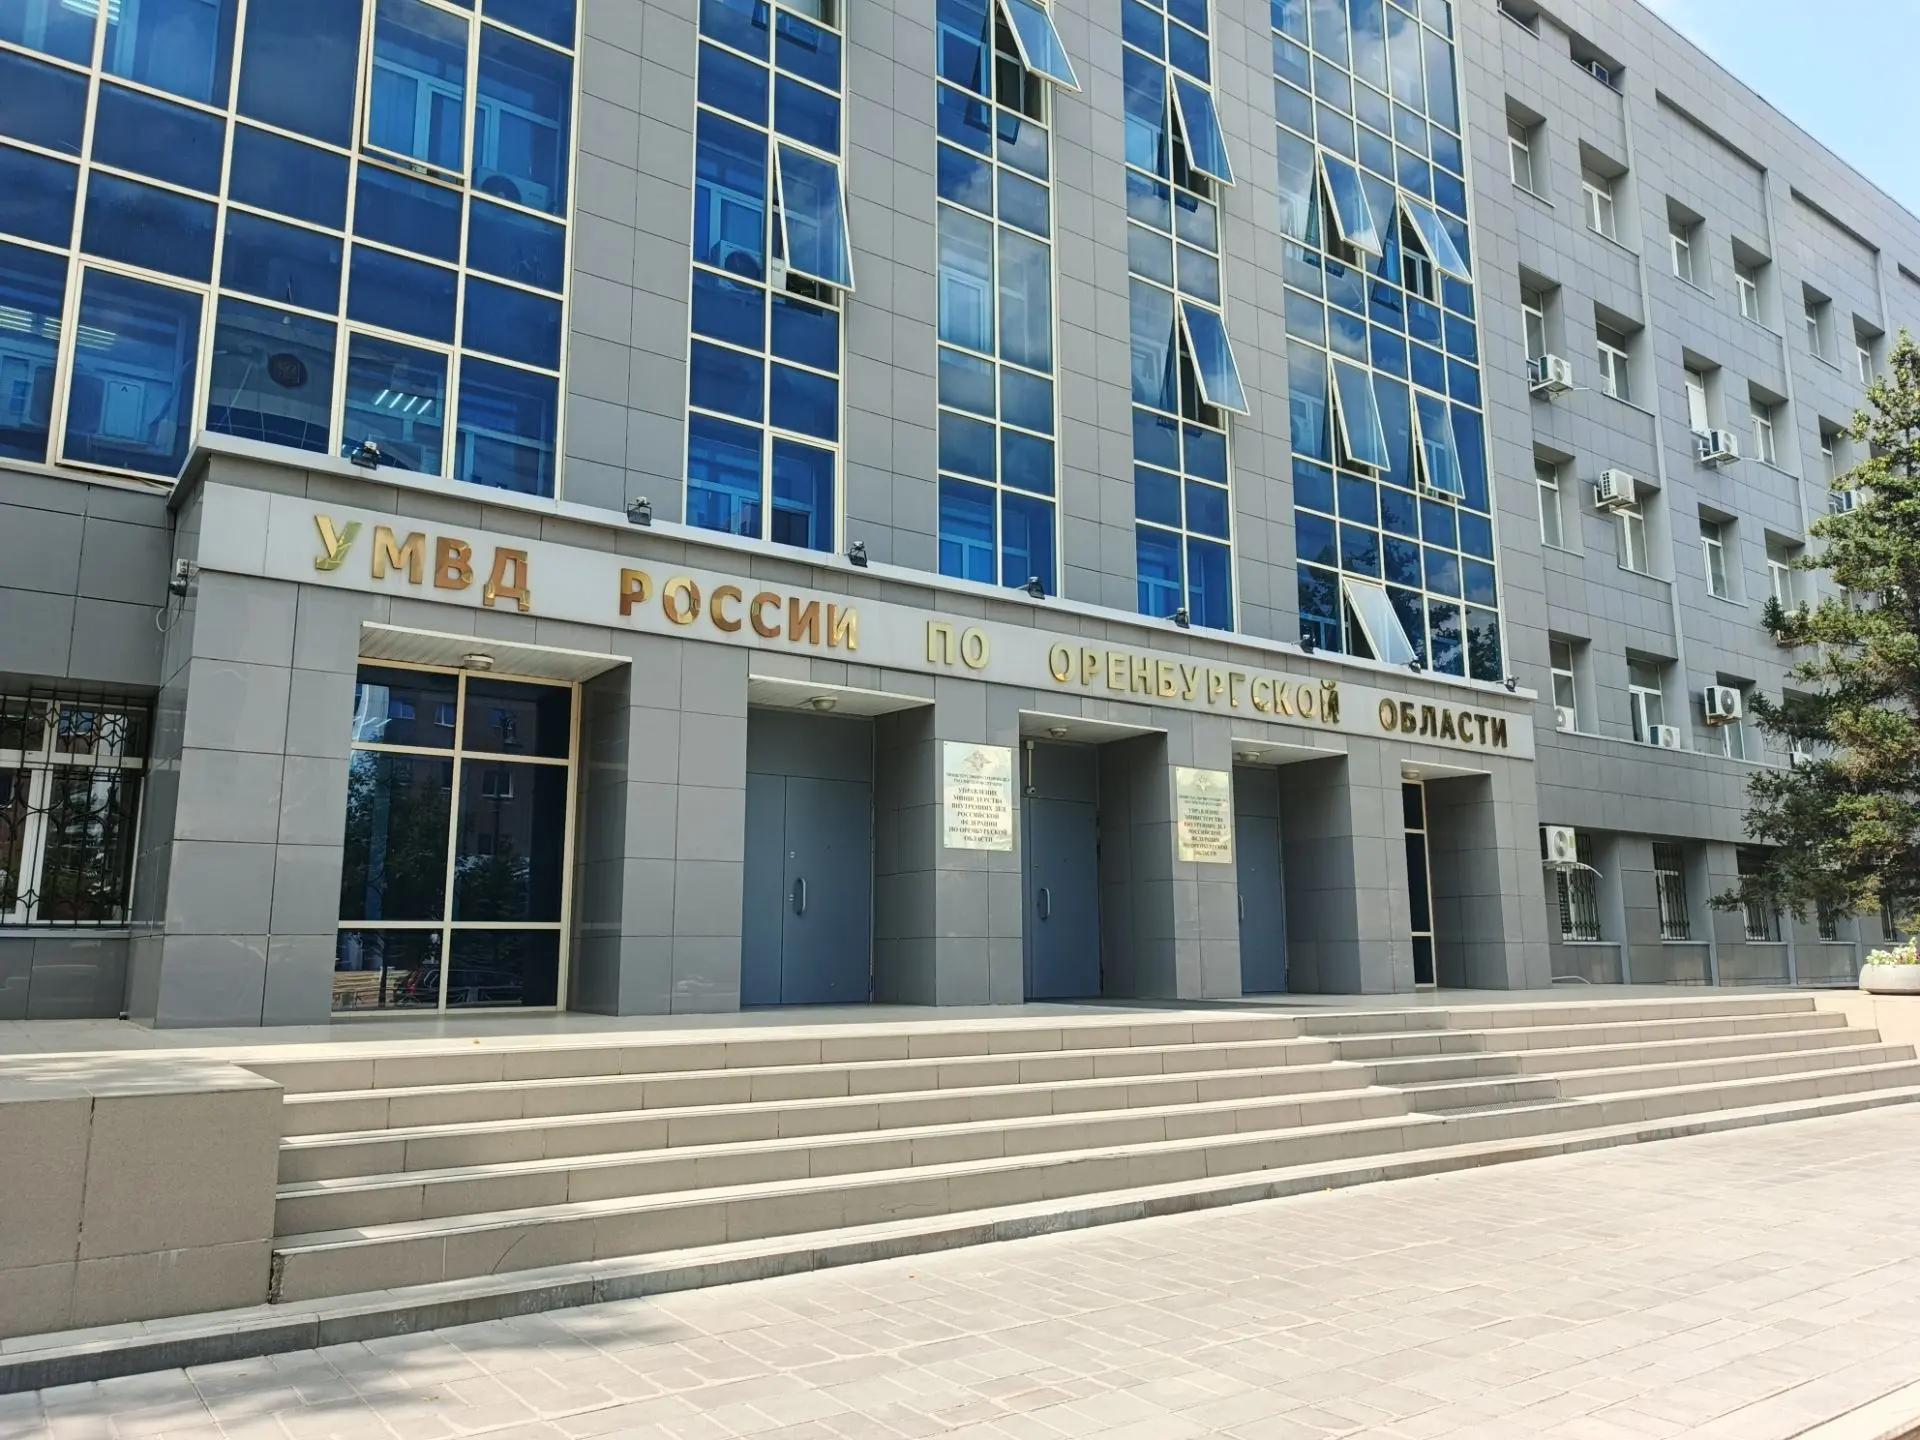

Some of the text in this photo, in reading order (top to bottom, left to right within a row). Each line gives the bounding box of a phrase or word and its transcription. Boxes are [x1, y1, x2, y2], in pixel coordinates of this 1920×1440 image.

[314, 514, 1509, 749] УМВД РОССИИ ПО ОРЕНБУРГСКОЙ ОБЛАСТИ
